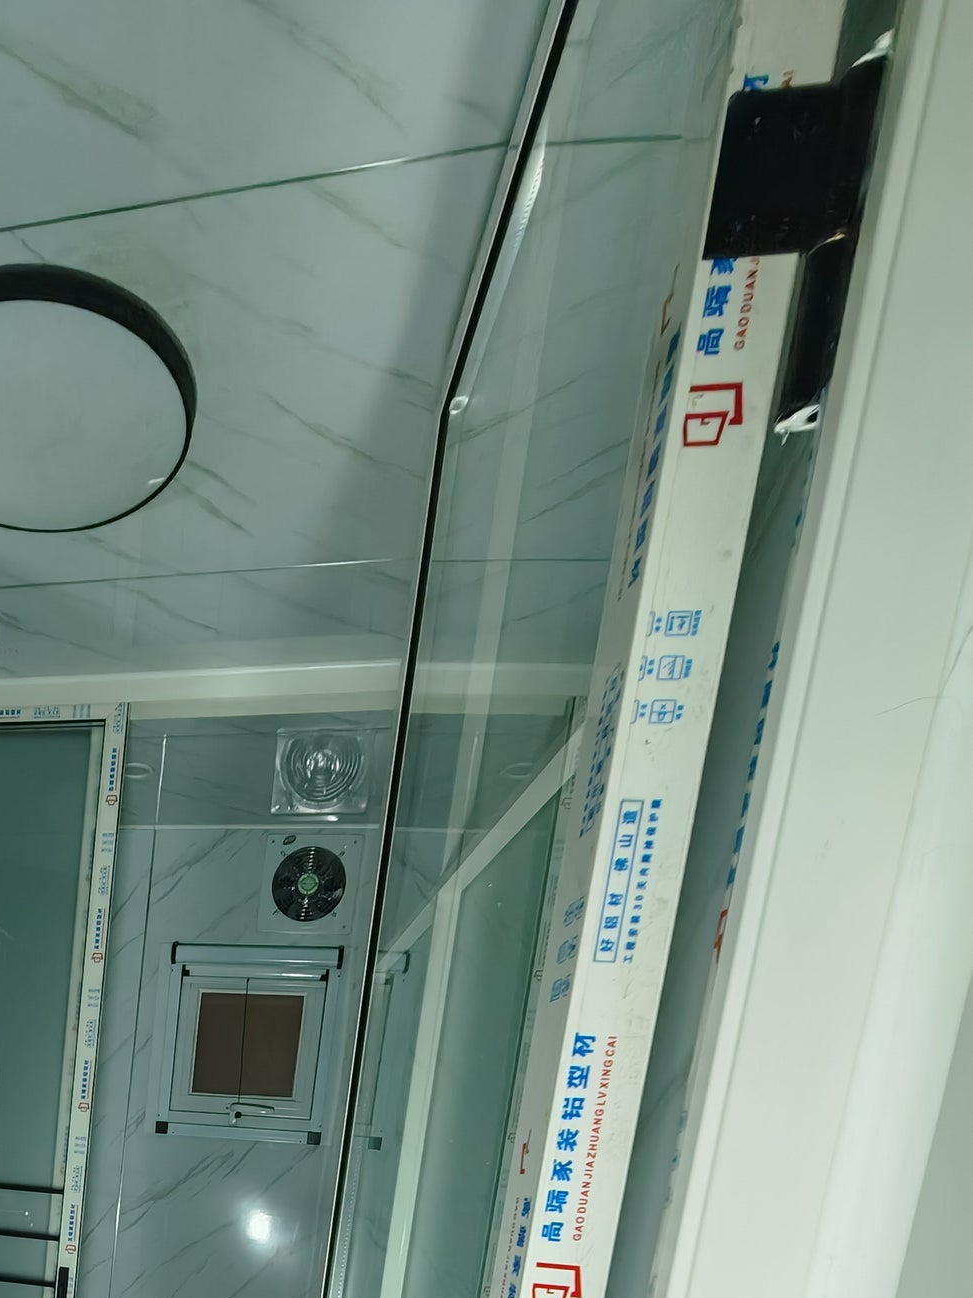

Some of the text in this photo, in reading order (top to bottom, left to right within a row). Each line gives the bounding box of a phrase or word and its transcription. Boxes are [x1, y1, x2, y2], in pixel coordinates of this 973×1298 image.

[539, 1032, 597, 1243] 高端家装铝型材
